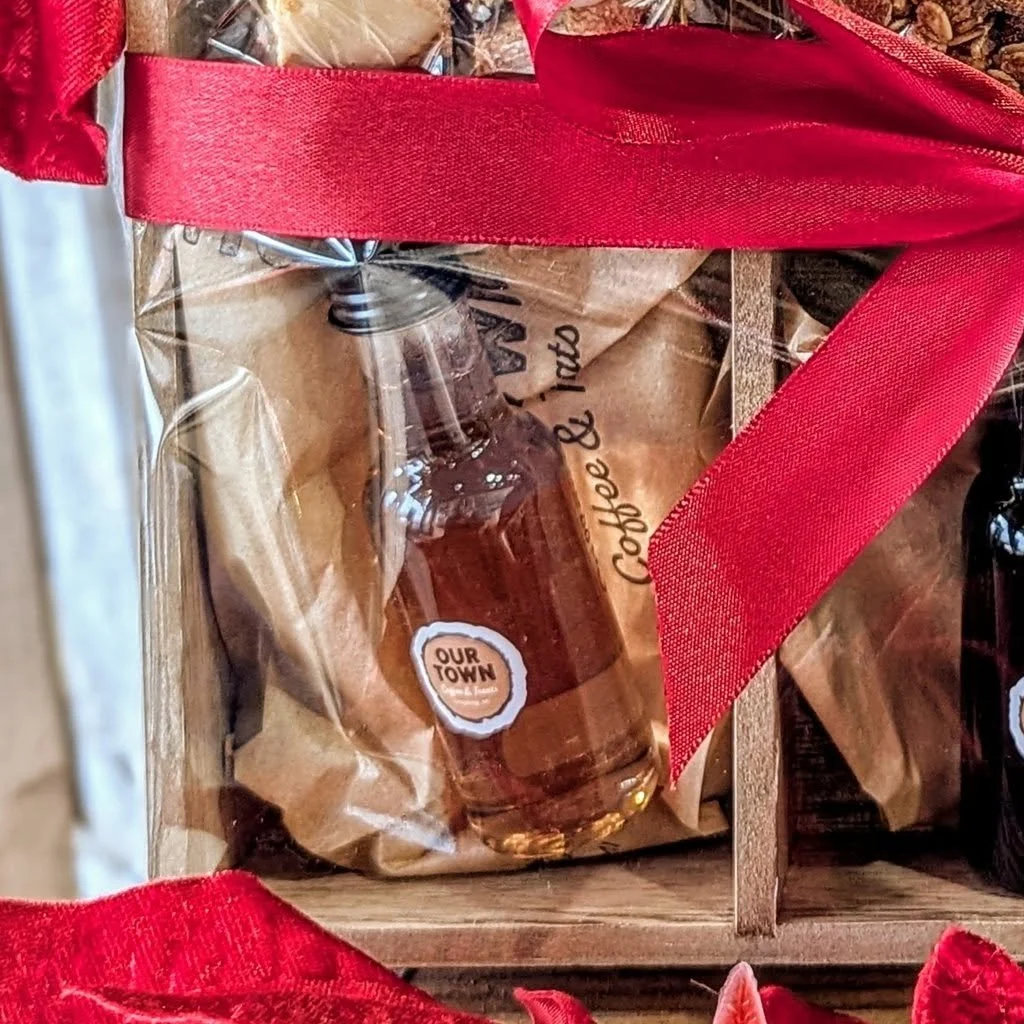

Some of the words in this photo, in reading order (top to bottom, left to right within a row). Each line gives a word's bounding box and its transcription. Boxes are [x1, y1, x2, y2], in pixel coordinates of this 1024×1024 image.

[553, 409, 600, 451] &
[585, 458, 652, 585] Coffee
[435, 647, 480, 665] OUR
[433, 663, 497, 684] TOWN
